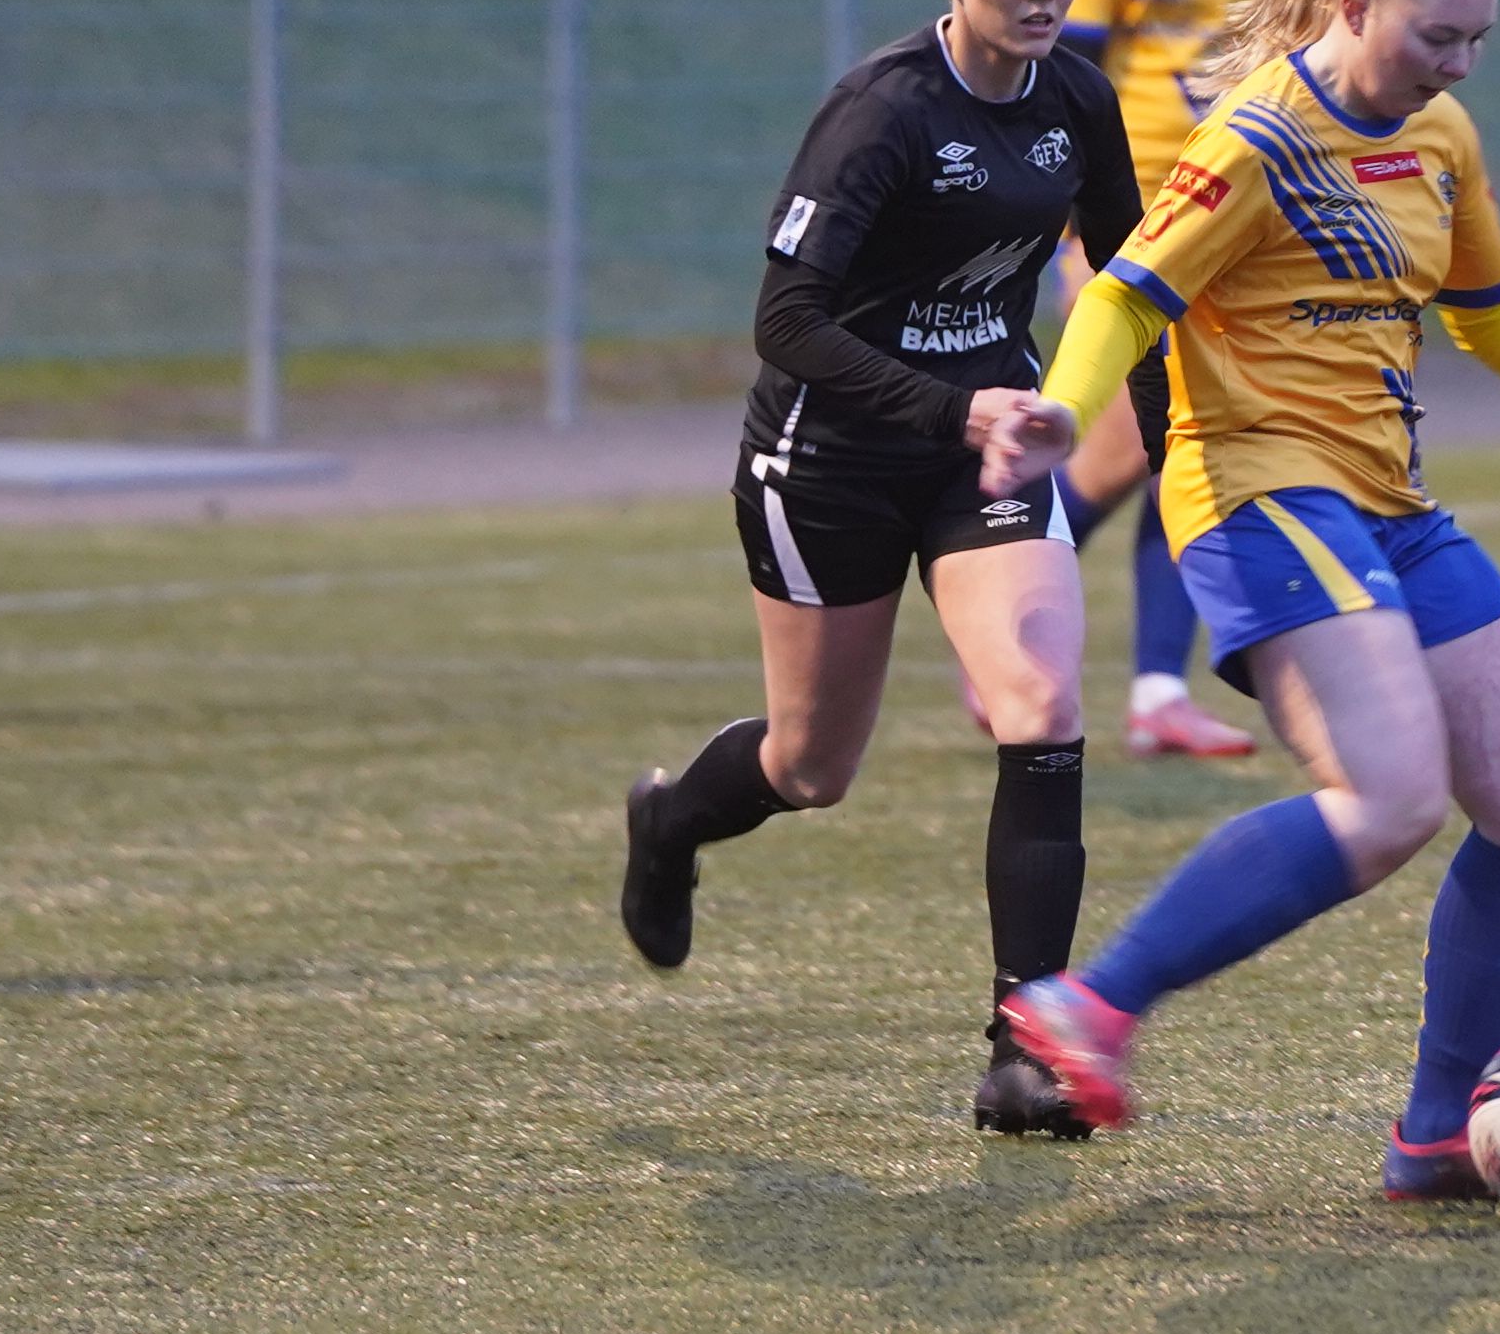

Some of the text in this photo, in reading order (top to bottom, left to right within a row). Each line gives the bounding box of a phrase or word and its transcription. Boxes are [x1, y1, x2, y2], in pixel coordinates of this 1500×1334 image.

[1033, 140, 1068, 167] GFK
[942, 162, 975, 174] umbro
[1320, 216, 1362, 230] umbro
[900, 315, 1009, 353] BANKEN
[986, 514, 1030, 528] umbro
